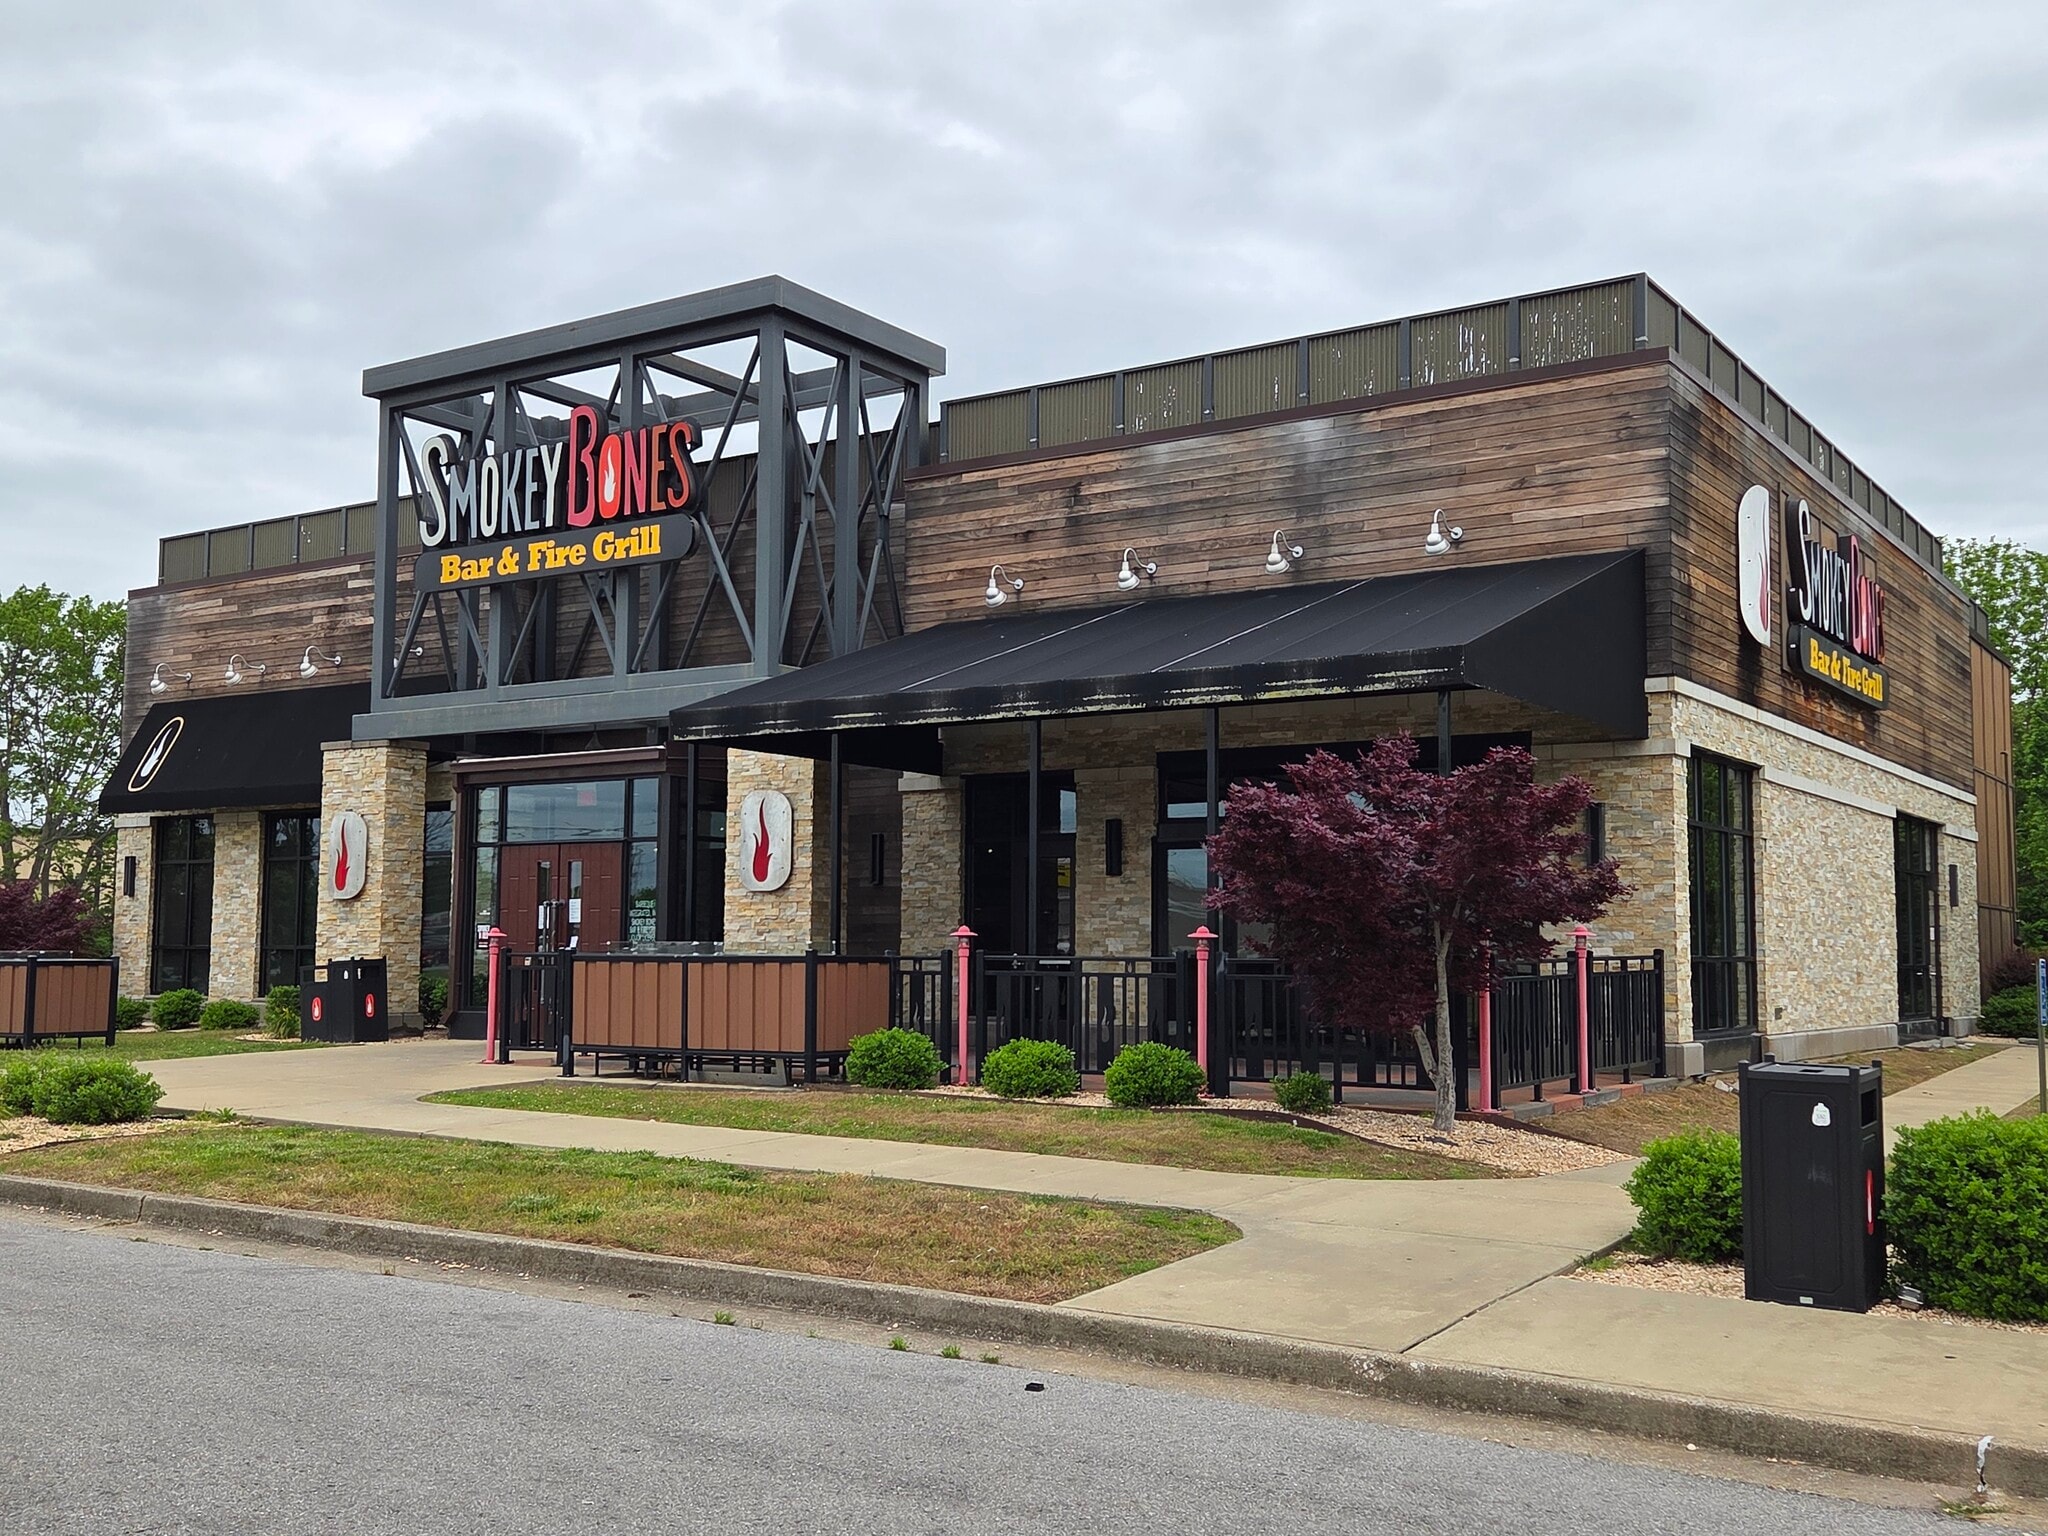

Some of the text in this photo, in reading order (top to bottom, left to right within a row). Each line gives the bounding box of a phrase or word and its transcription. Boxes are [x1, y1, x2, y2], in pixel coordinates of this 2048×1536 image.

[419, 405, 694, 547] SMOKEY BONES
[440, 524, 662, 584] Bar & Fire Grill
[1799, 499, 1850, 643] SMOKEY
[1809, 637, 1884, 702] Bar & Fire Grill
